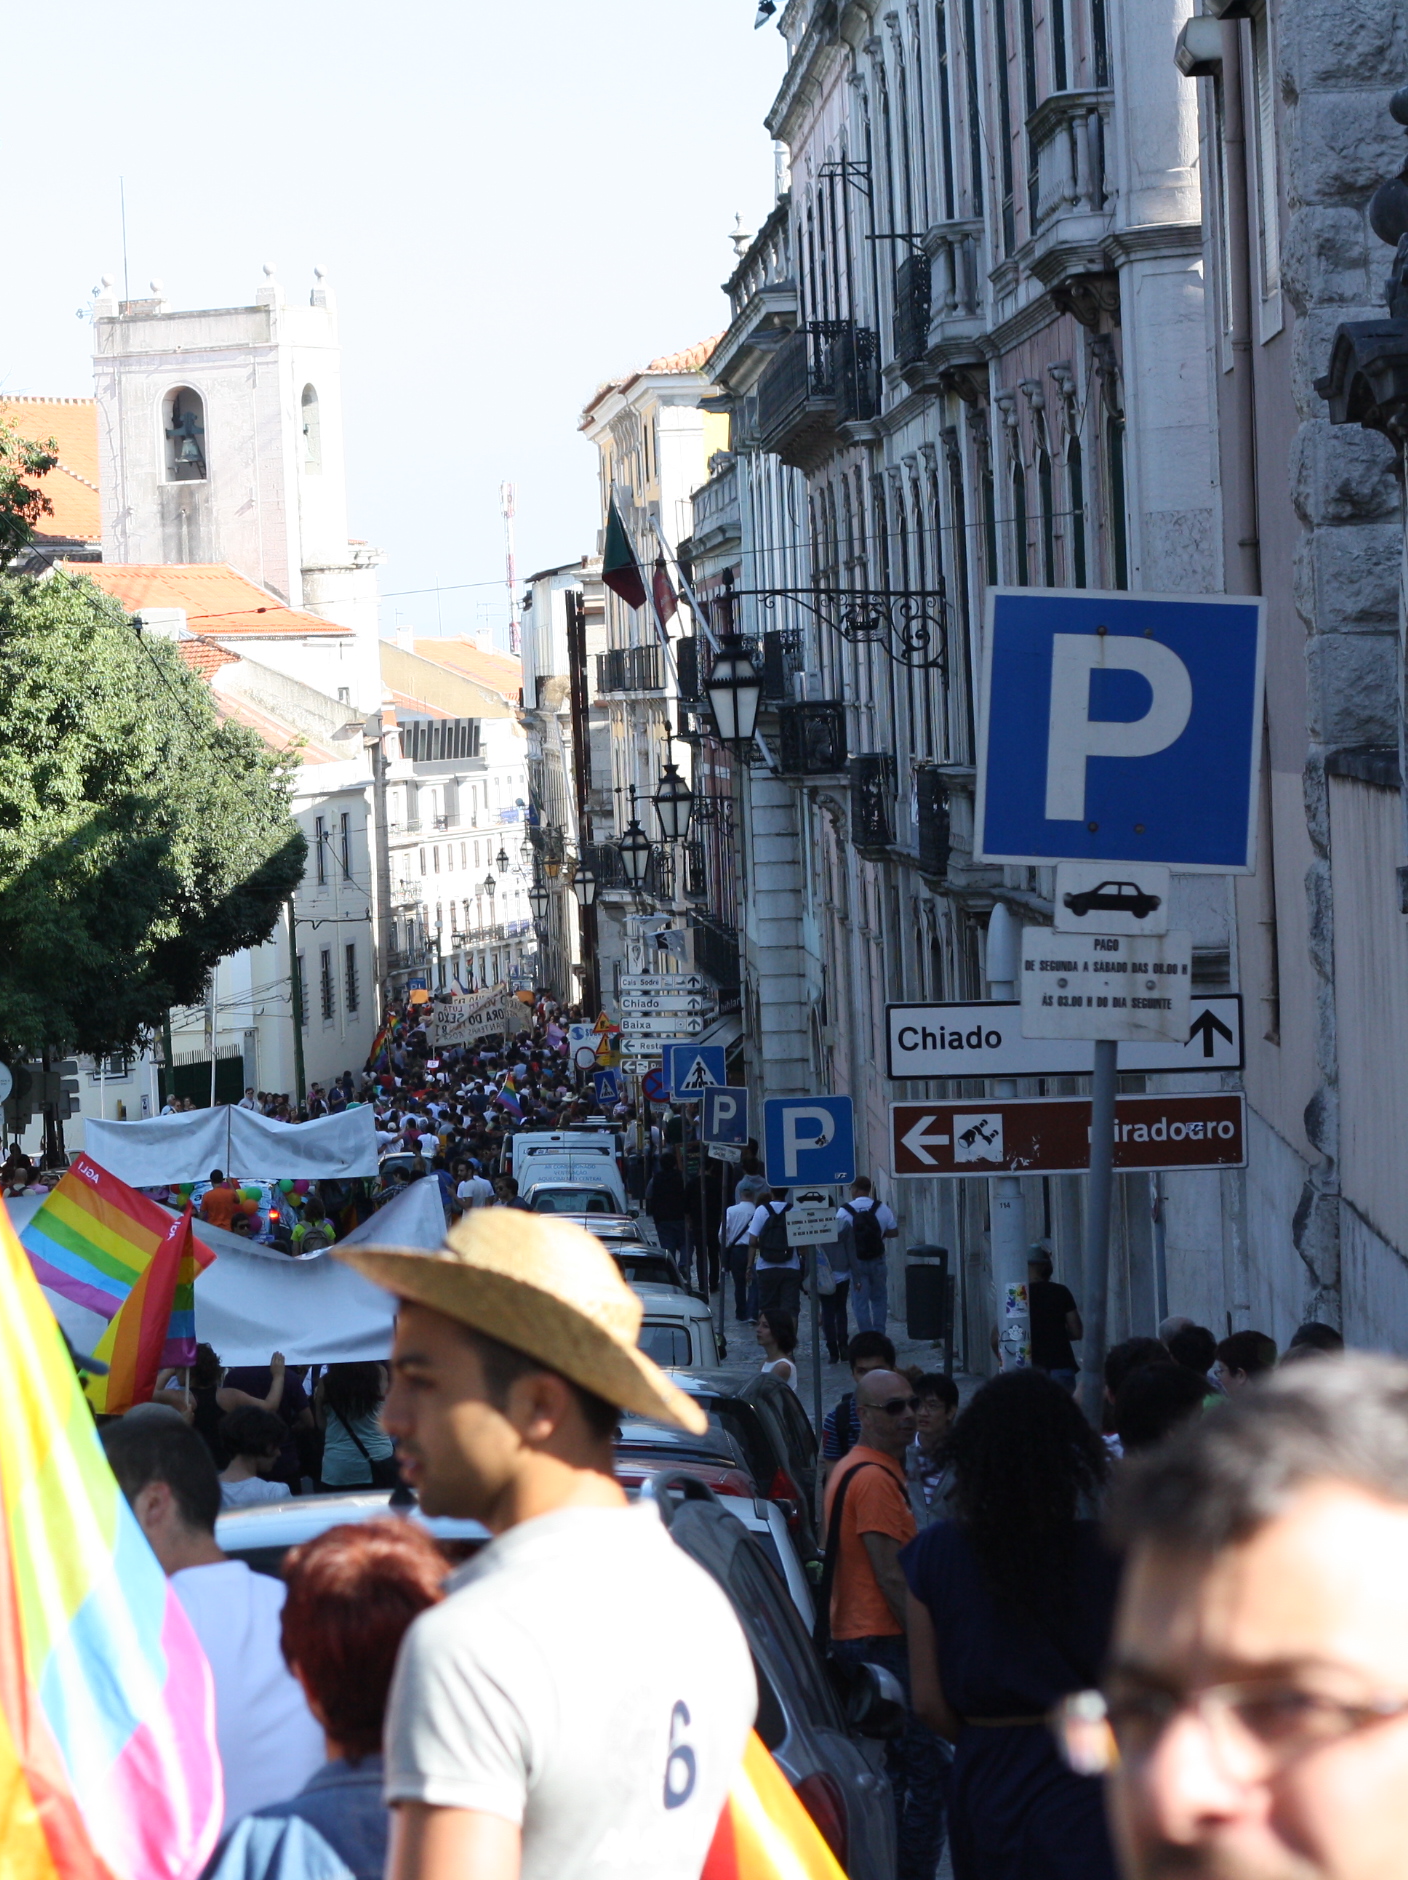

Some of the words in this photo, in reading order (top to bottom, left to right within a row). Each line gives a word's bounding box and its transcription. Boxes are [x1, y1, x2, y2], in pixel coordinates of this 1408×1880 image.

[1044, 632, 1193, 821] P
[1094, 938, 1119, 952] PAGO
[1025, 960, 1036, 971] DE
[1039, 960, 1079, 972] SEGUNDA
[1082, 961, 1089, 972] A
[1131, 962, 1149, 974] DAS
[1181, 964, 1188, 975] H
[622, 999, 660, 1008] Chiado
[1096, 996, 1108, 1008] DO
[1112, 997, 1128, 1008] DIA
[1131, 997, 1172, 1010] SEGUINTE
[622, 1021, 652, 1029] Baixa
[898, 1024, 1003, 1052] Chiado
[712, 1095, 737, 1135] P
[781, 1106, 836, 1178] P
[1087, 1116, 1235, 1144] iradouro
[663, 1699, 697, 1810] 6
